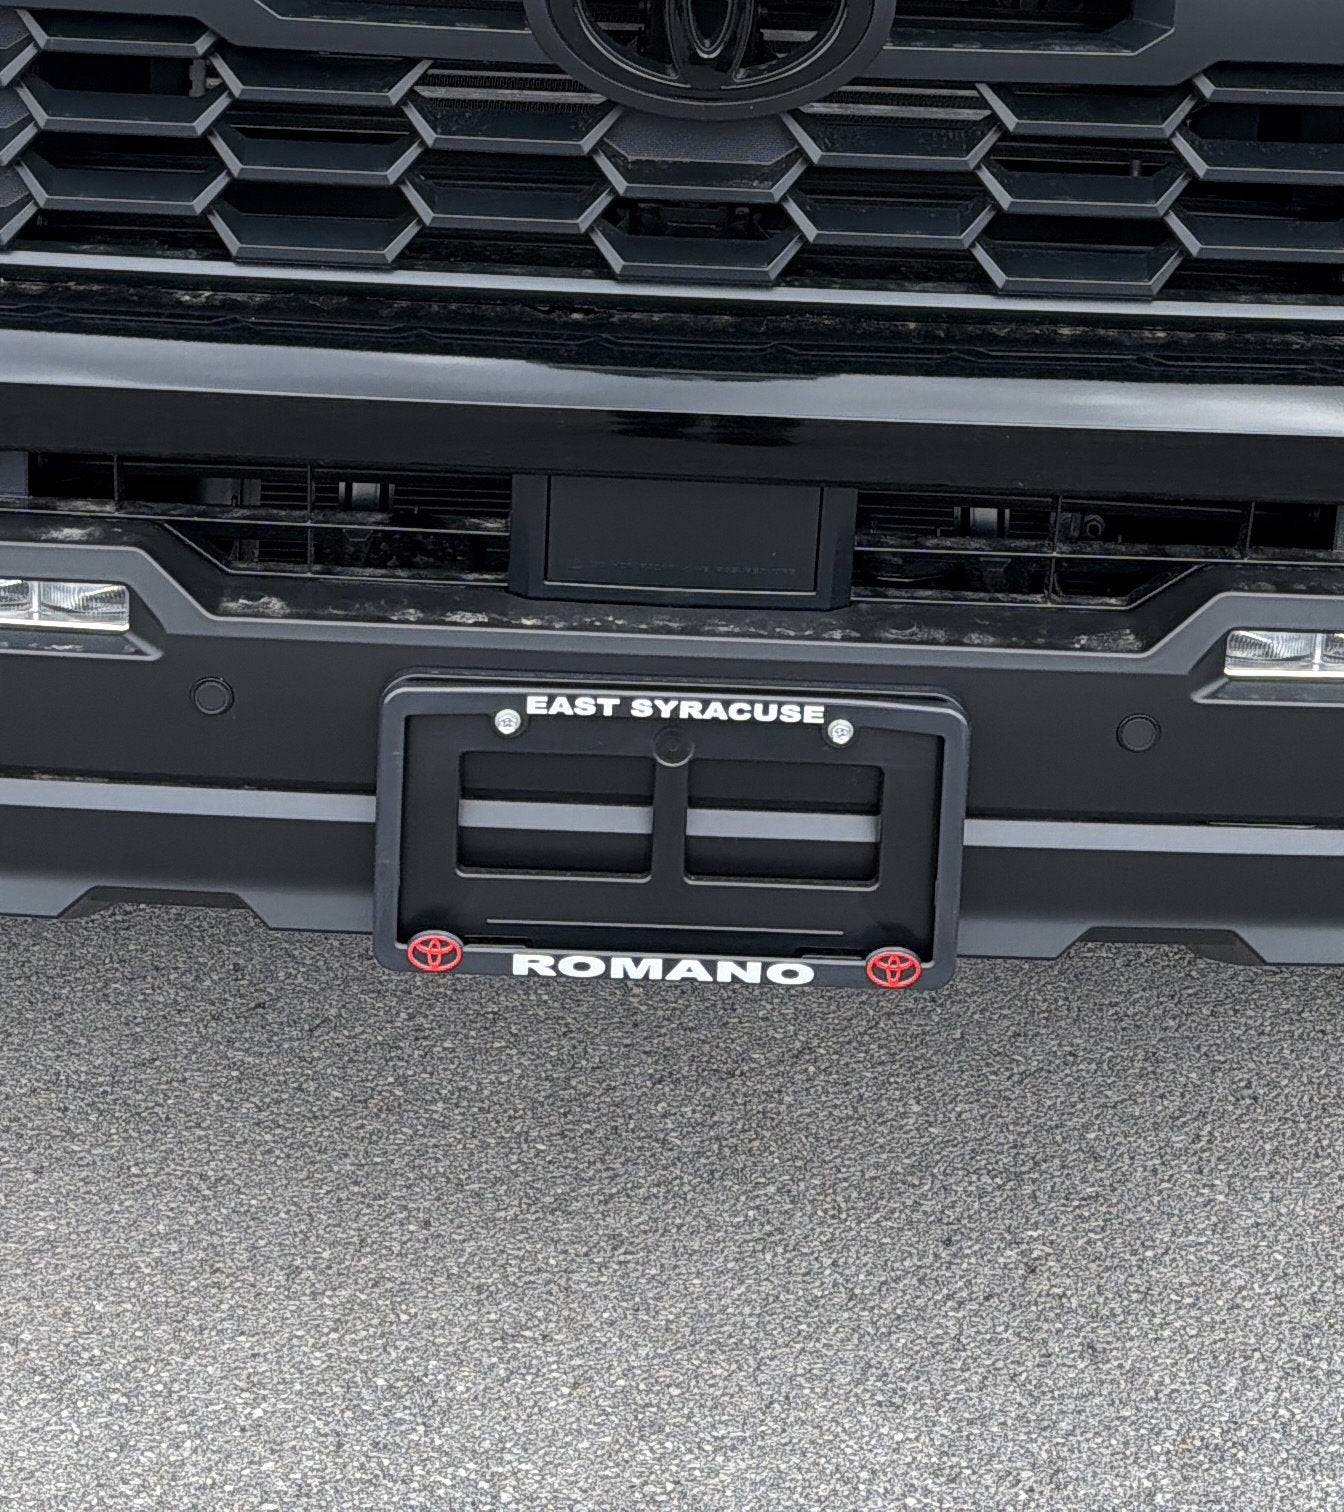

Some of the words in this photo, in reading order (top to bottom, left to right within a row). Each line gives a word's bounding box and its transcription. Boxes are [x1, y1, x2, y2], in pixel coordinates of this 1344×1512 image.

[526, 695, 621, 717] EAST
[630, 698, 825, 724] SYRACUSE
[512, 953, 815, 985] ROMANO
